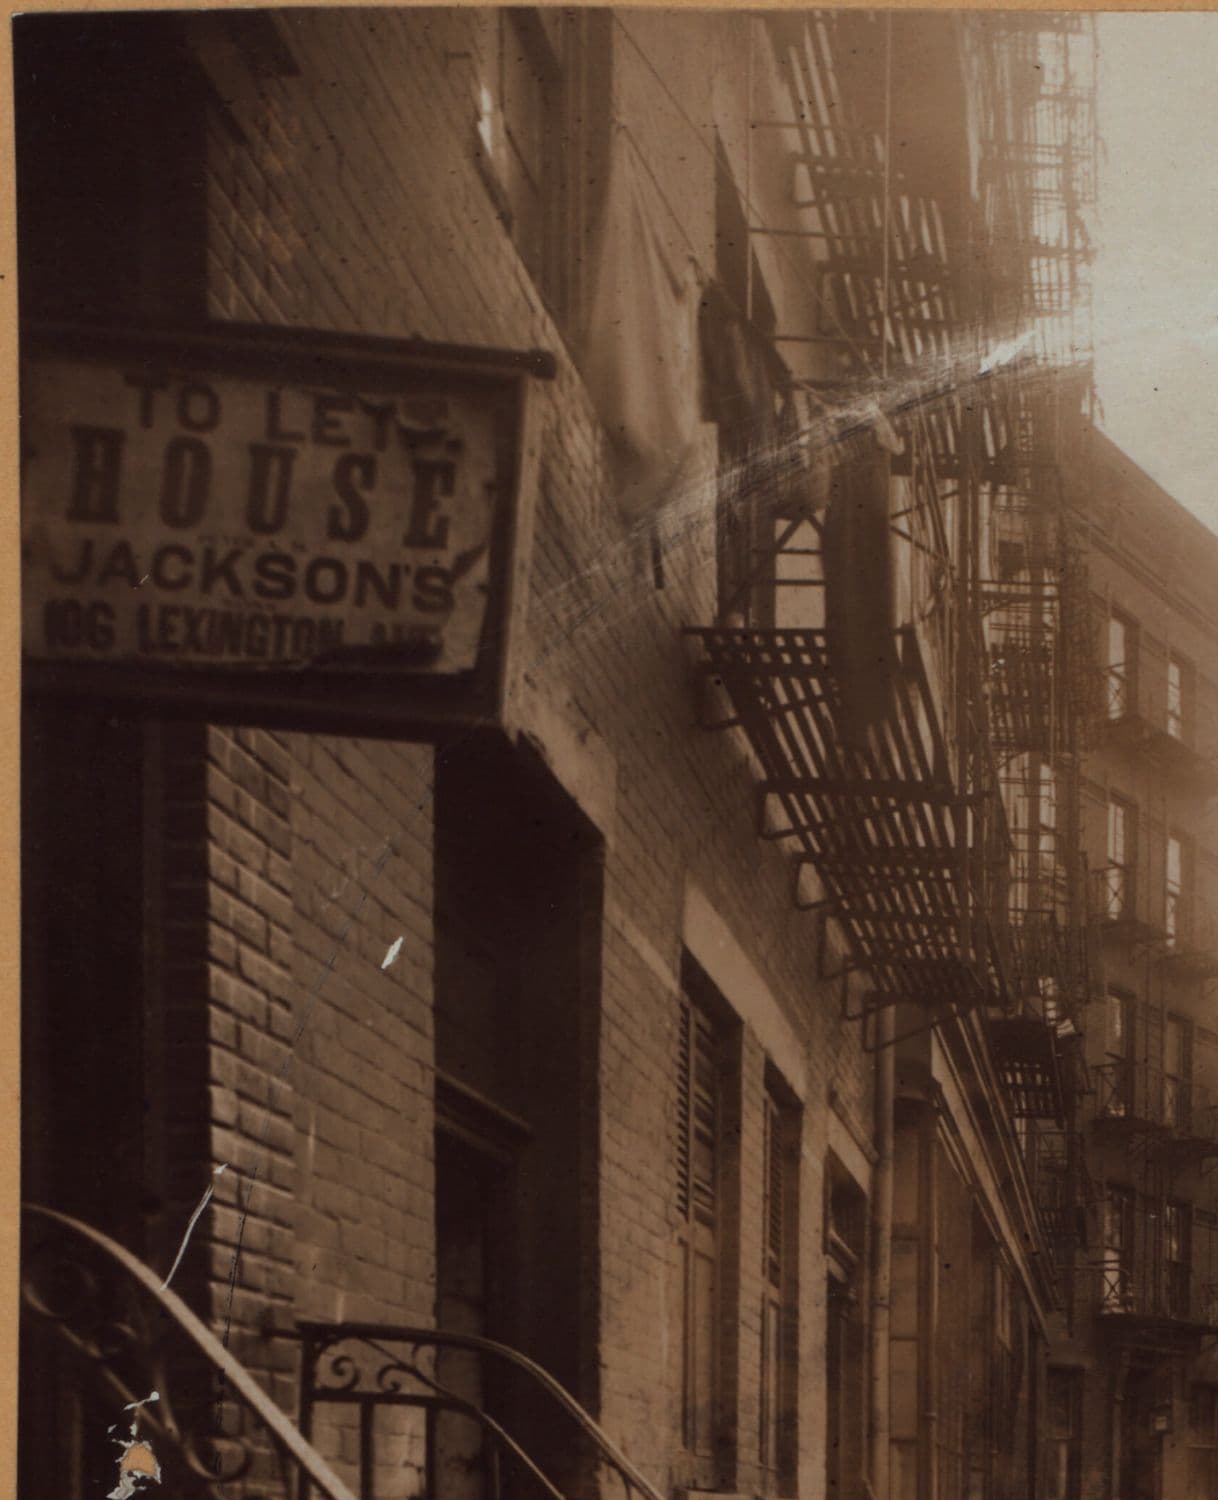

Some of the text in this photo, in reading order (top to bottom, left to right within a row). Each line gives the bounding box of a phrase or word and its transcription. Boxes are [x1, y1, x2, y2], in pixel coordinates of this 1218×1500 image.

[122, 368, 223, 433] TO
[66, 422, 457, 550] HOUSE
[50, 538, 456, 614] JACKSON'S
[136, 604, 345, 662] LEXINGTON
